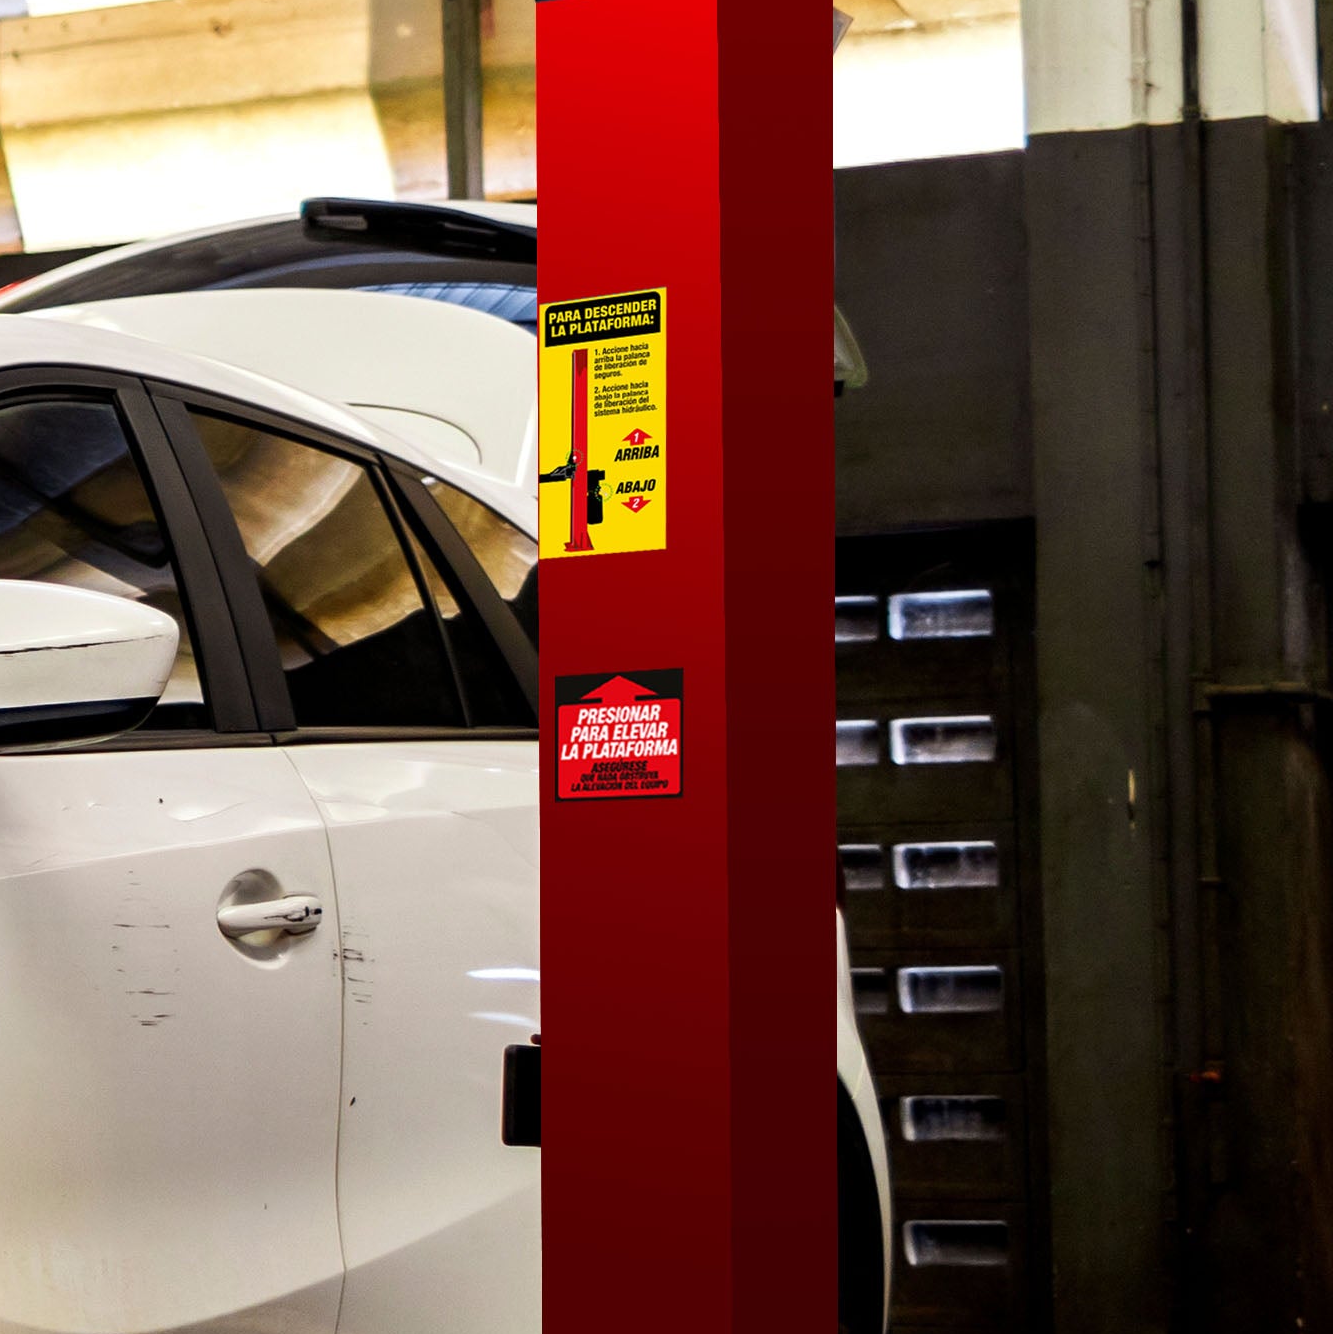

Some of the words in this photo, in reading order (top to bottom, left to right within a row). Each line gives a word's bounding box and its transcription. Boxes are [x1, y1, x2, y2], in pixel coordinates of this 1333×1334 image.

[549, 309, 581, 324] PARA
[585, 299, 657, 319] DESCENDER
[551, 325, 566, 338] LA
[569, 313, 654, 335] PLATAFORMA:
[602, 346, 629, 355] Accione
[630, 342, 649, 351] hacia
[594, 356, 614, 364] arriba
[623, 351, 650, 361] palanca
[594, 386, 601, 394] 2.
[602, 383, 629, 393] Accione
[630, 380, 649, 389] hacia
[594, 393, 613, 402] abajo
[622, 390, 649, 399] palanca
[638, 396, 649, 404] del
[634, 432, 639, 443] 1
[614, 445, 660, 462] ARRIBA
[615, 479, 656, 494] ABAJO
[632, 498, 640, 508] 2
[577, 704, 661, 725] PRESIONAR
[570, 725, 609, 742] PARA
[613, 722, 669, 741] ELEVAR
[560, 743, 579, 760] LA
[582, 739, 678, 760] PLATAFORMA
